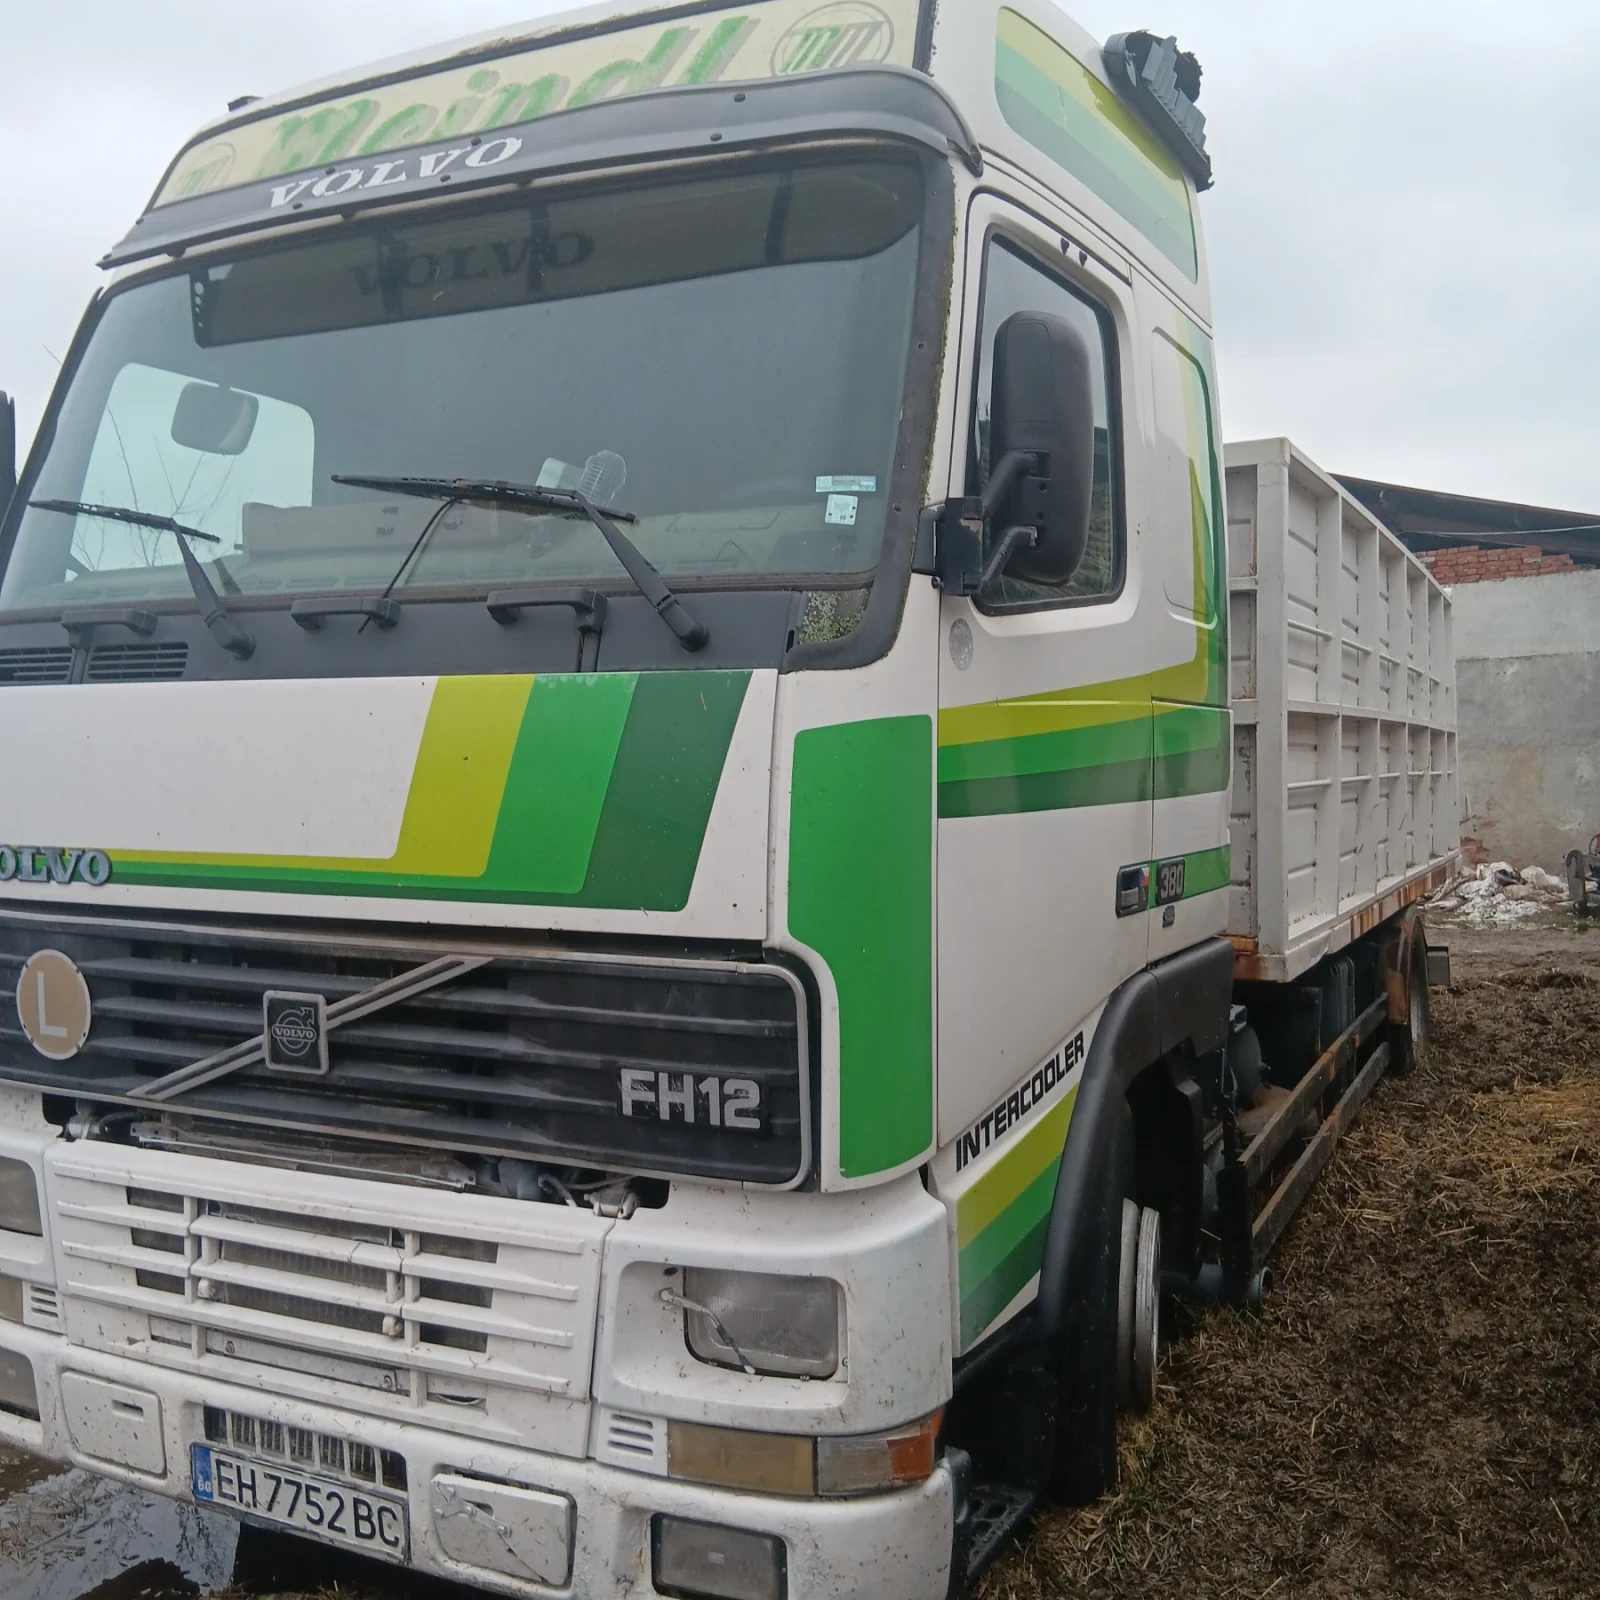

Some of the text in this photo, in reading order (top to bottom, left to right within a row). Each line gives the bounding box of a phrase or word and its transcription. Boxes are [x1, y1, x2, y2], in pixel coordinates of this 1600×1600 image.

[269, 136, 523, 208] VOLVO
[1160, 864, 1184, 898] 380
[37, 971, 68, 1038] L
[274, 1027, 314, 1039] VOLVO
[619, 1067, 762, 1130] FH12
[955, 1031, 1085, 1172] INTERCOOLER
